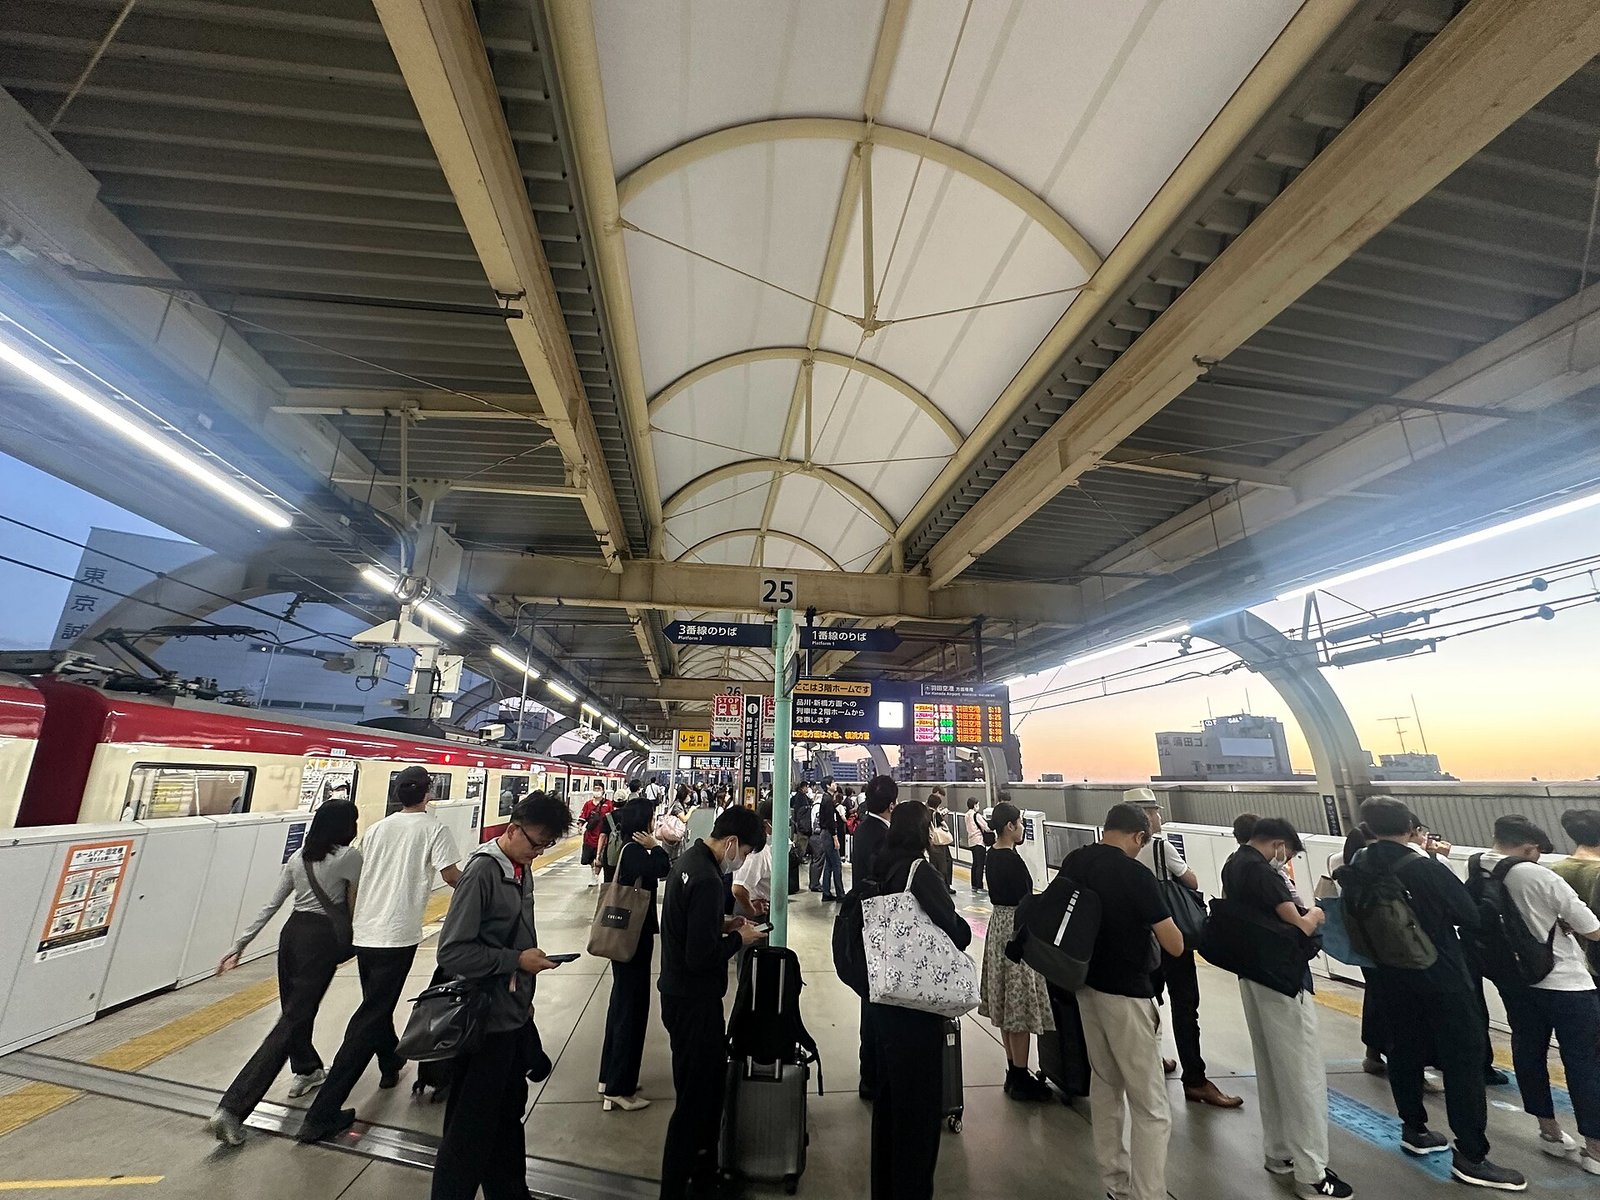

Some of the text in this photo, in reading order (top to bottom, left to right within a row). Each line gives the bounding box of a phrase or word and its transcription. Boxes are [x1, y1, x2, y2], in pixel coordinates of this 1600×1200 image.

[763, 579, 794, 604] 25
[678, 624, 738, 637] 3番線のりば
[811, 630, 867, 642] 1番線のりば
[726, 686, 741, 696] 26
[794, 682, 870, 694] ここは3階ホームです
[796, 708, 866, 717] 列車は2階ホームから
[649, 756, 656, 765] 3
[1322, 1181, 1335, 1196] N
